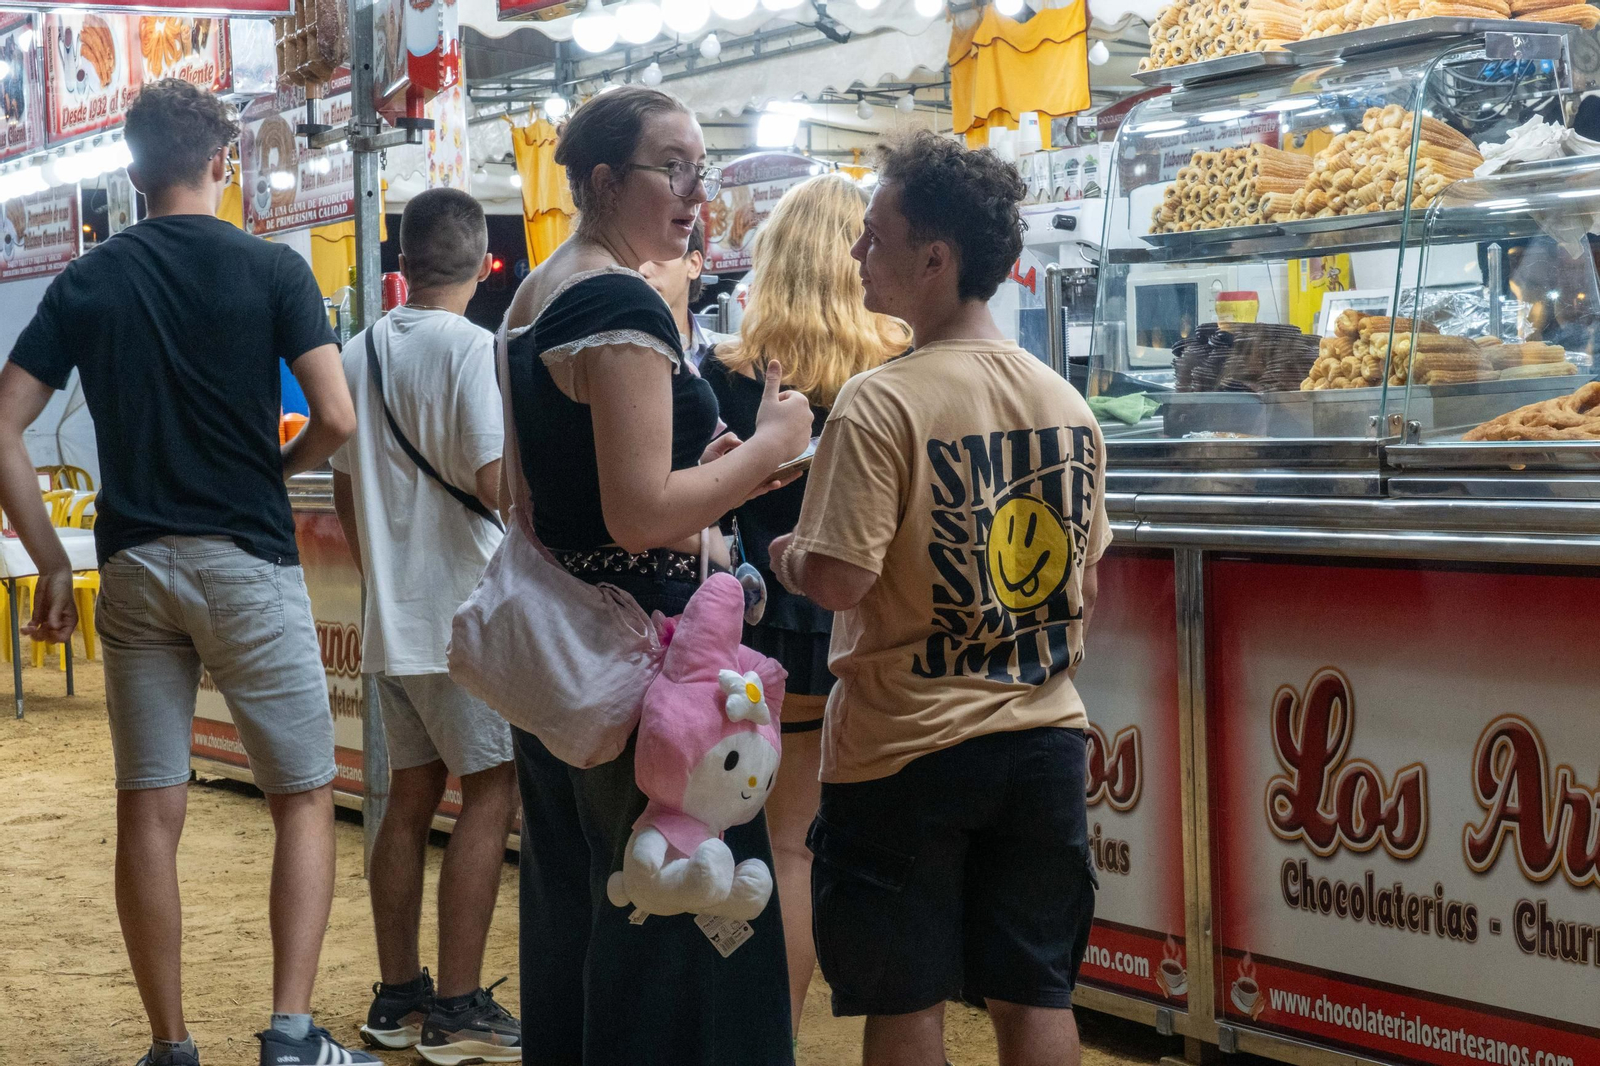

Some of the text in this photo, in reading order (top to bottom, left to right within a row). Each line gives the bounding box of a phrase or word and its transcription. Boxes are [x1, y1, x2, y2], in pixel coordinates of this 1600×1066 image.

[62, 100, 87, 128] Desde
[89, 95, 107, 120] 1932
[110, 89, 119, 113] al
[266, 203, 348, 230] DE PRIMERISIMA CALIDAD
[275, 204, 287, 217] UNA
[288, 200, 306, 214] GAMA
[307, 197, 317, 209] DE
[1006, 257, 1036, 296] LA
[926, 426, 1096, 510] SMILE
[335, 765, 364, 782] rtesano.
[1265, 665, 1600, 887] Los Ar
[1281, 858, 1479, 943] Chocolaterias
[1269, 987, 1574, 1066] www.chocolaterialosartesanos.com
